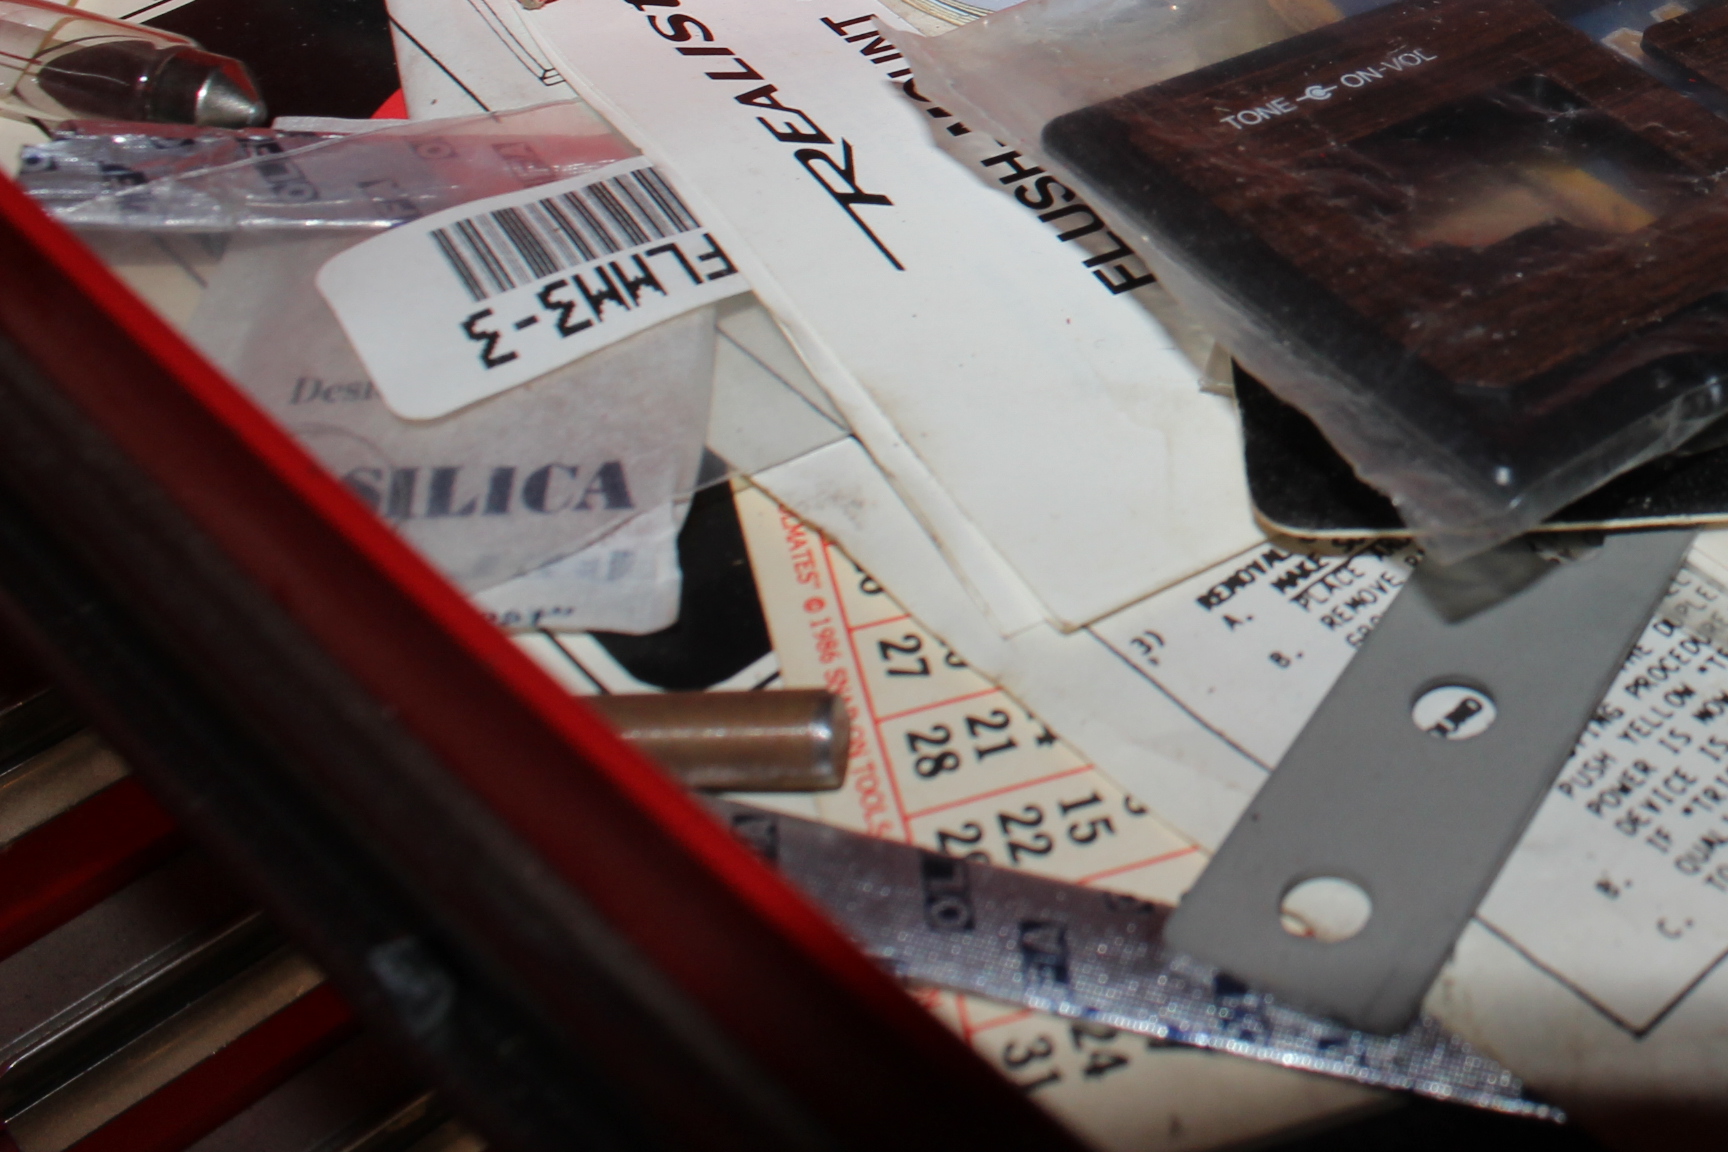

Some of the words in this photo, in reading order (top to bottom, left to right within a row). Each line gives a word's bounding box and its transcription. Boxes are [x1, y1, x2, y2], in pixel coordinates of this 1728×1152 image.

[1219, 97, 1298, 130] TONE
[1339, 48, 1438, 89] ON-VOL
[460, 231, 739, 370] FLMM3-3
[807, 611, 851, 670] 1986
[878, 634, 933, 681] 27
[905, 724, 961, 780] 28
[964, 709, 1020, 763] 21
[1555, 749, 1618, 800] PUSH
[1617, 681, 1697, 747] YELLOW
[1585, 759, 1658, 818] POWER
[1657, 727, 1693, 757] IS
[1058, 793, 1118, 846] 15
[1614, 767, 1699, 839] DEVICE
[997, 804, 1055, 866] 22
[1003, 1036, 1064, 1094] 31
